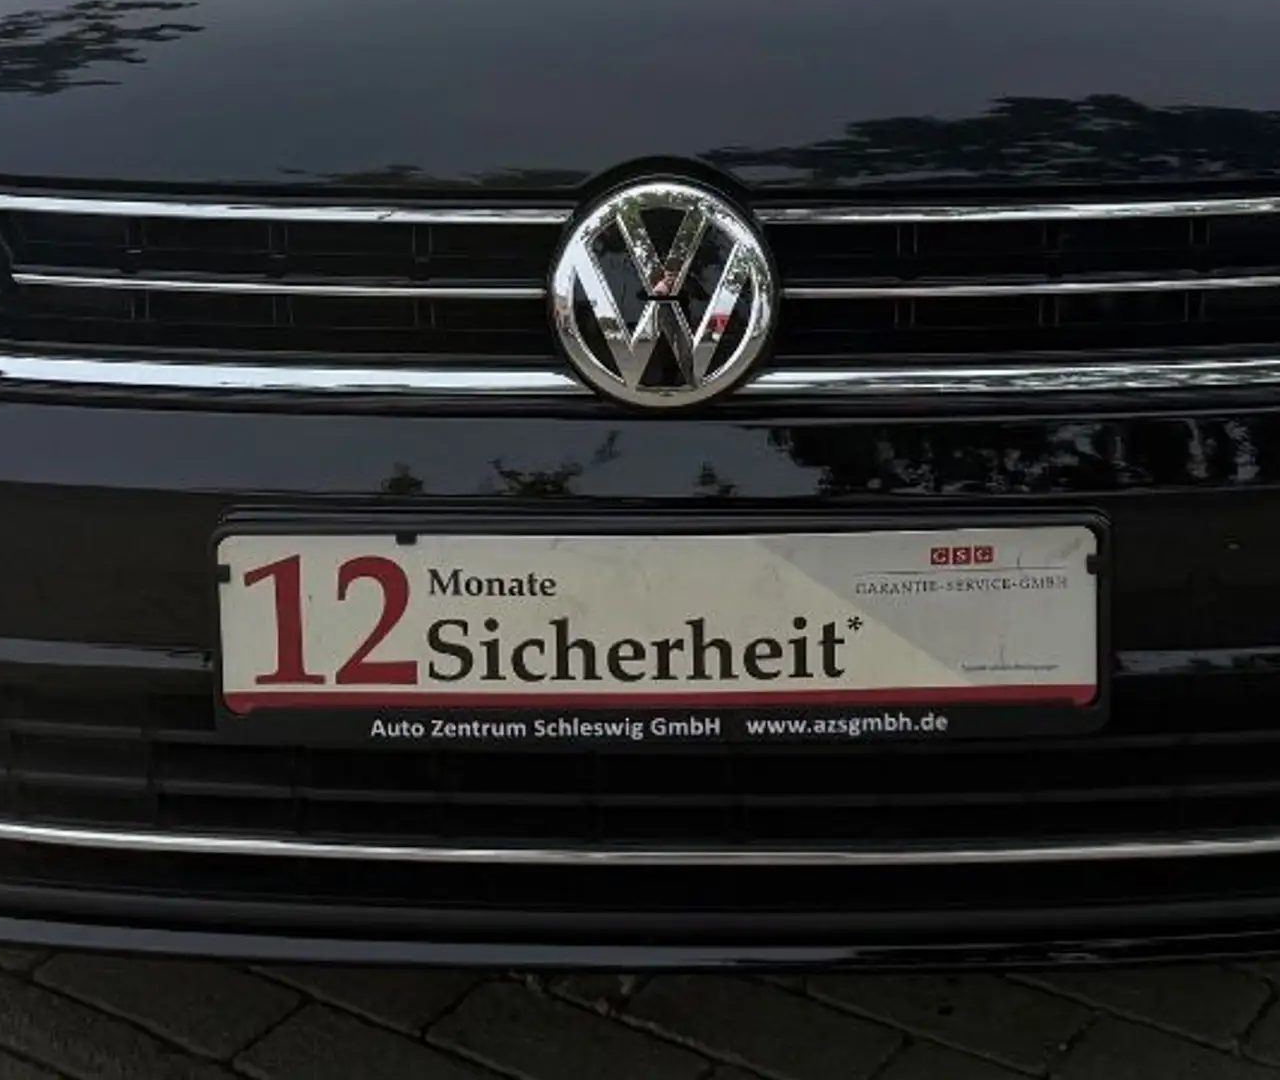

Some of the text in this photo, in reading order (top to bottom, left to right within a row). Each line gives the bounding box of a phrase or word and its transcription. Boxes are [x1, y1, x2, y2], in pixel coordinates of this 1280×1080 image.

[427, 568, 557, 597] Monate
[243, 553, 418, 685] 12
[370, 717, 720, 740] Auto Zentrum Schleswig GmbH
[746, 712, 949, 737] www.azsgmbh.de
